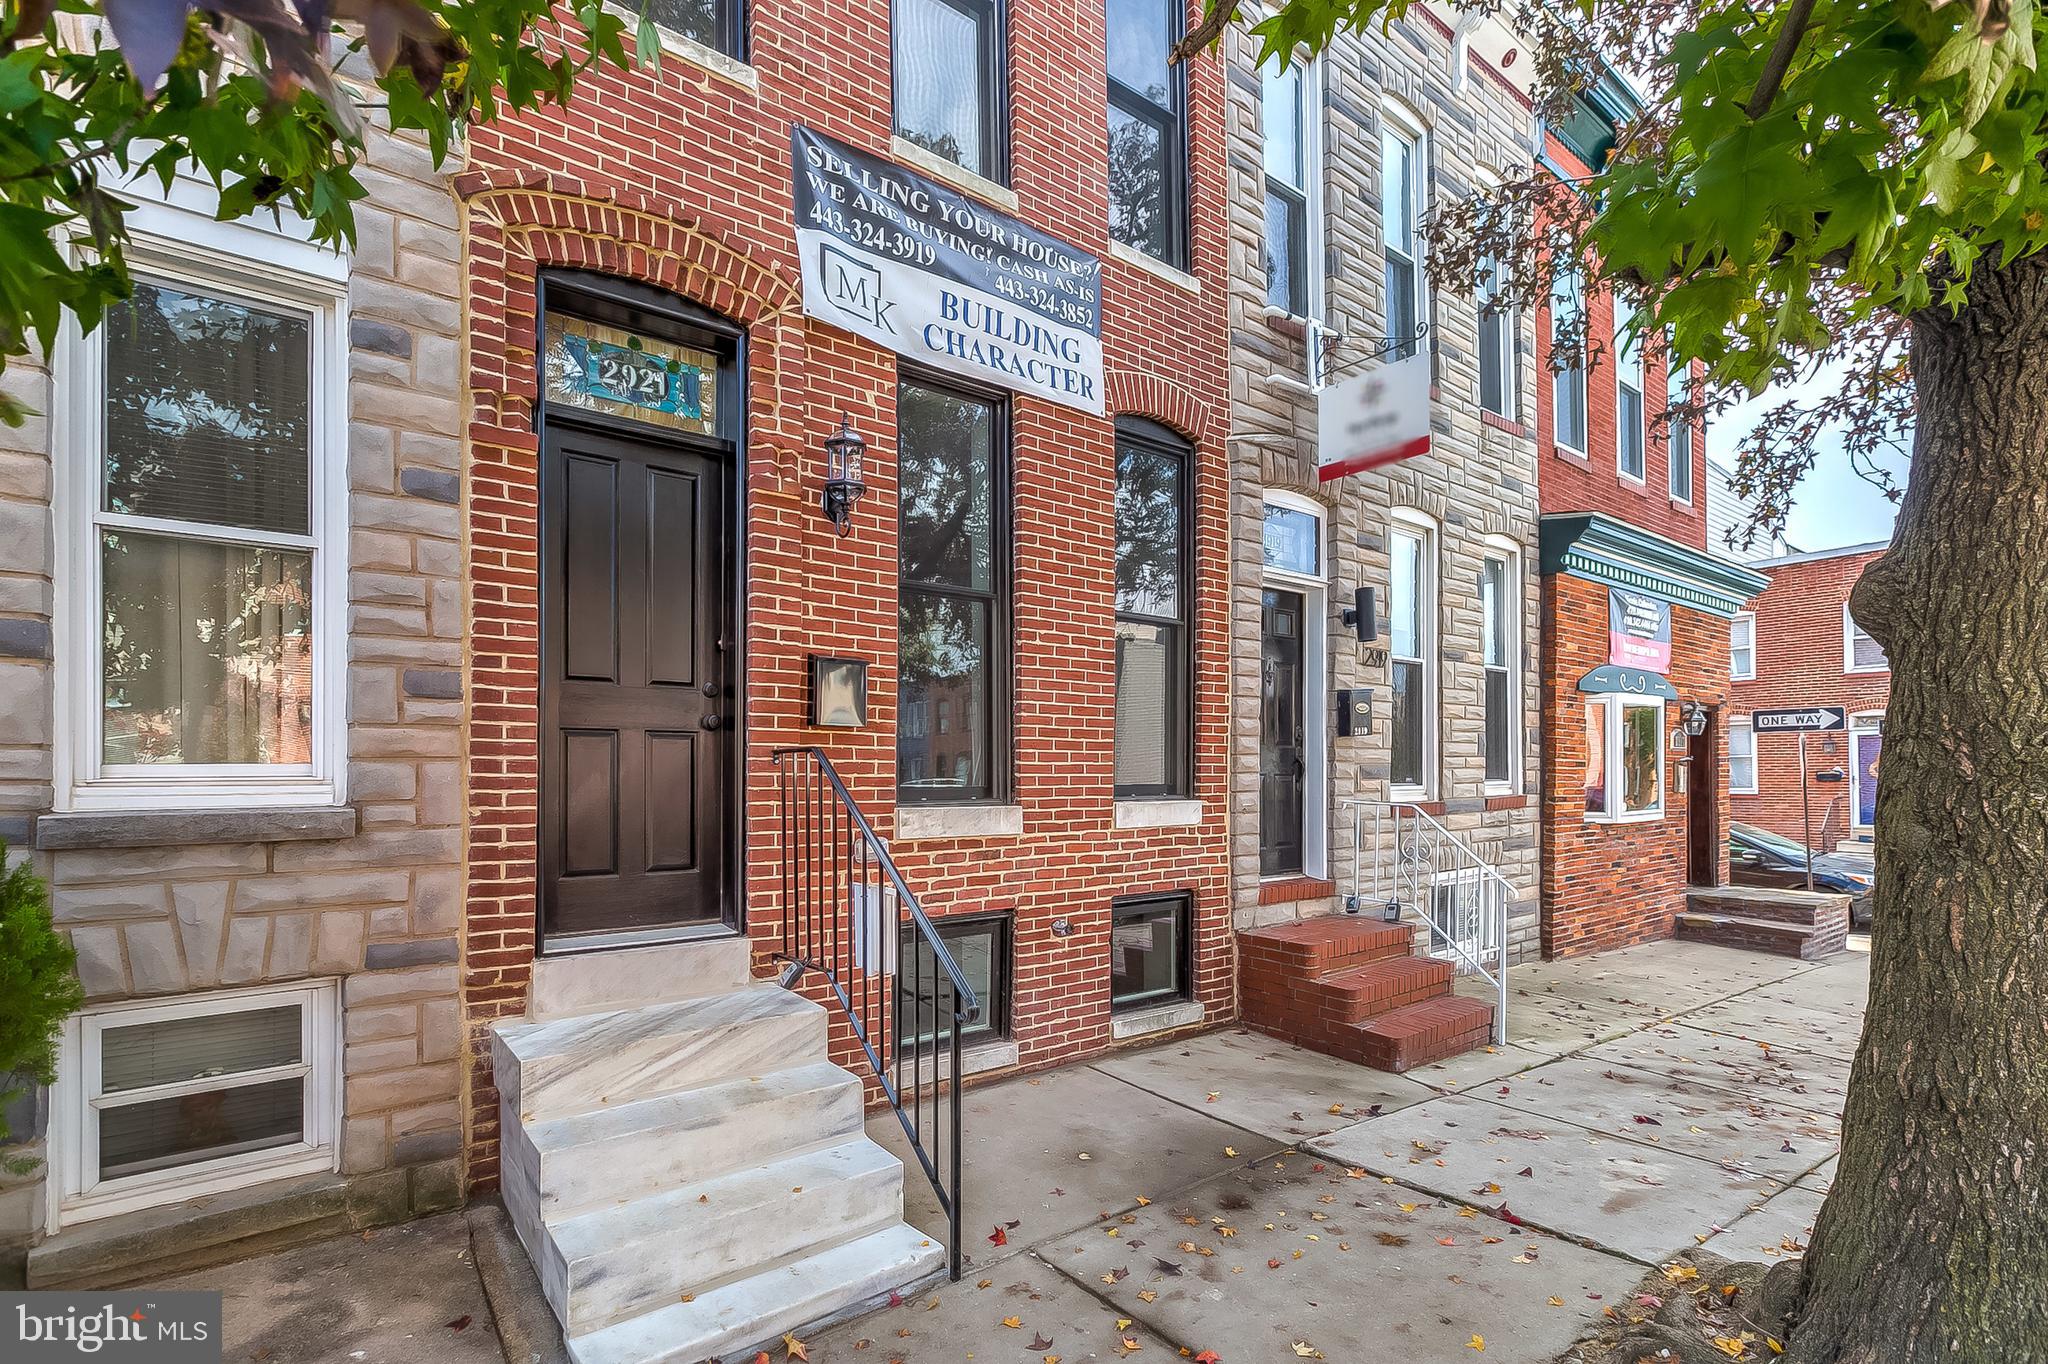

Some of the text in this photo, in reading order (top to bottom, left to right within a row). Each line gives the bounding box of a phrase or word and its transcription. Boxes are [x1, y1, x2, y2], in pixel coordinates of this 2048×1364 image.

[806, 145, 931, 214] SELLING
[937, 199, 1008, 247] YOUR
[806, 171, 1095, 303] WE ARE BUYING! CASH AS-IS
[810, 200, 936, 266] 443-324-3919
[939, 289, 1081, 364] BUILDING
[994, 275, 1094, 330] 443-324-3852
[601, 359, 666, 396] 2921
[923, 323, 1096, 401] CHARACTER
[1761, 714, 1823, 726] ONE WAY
